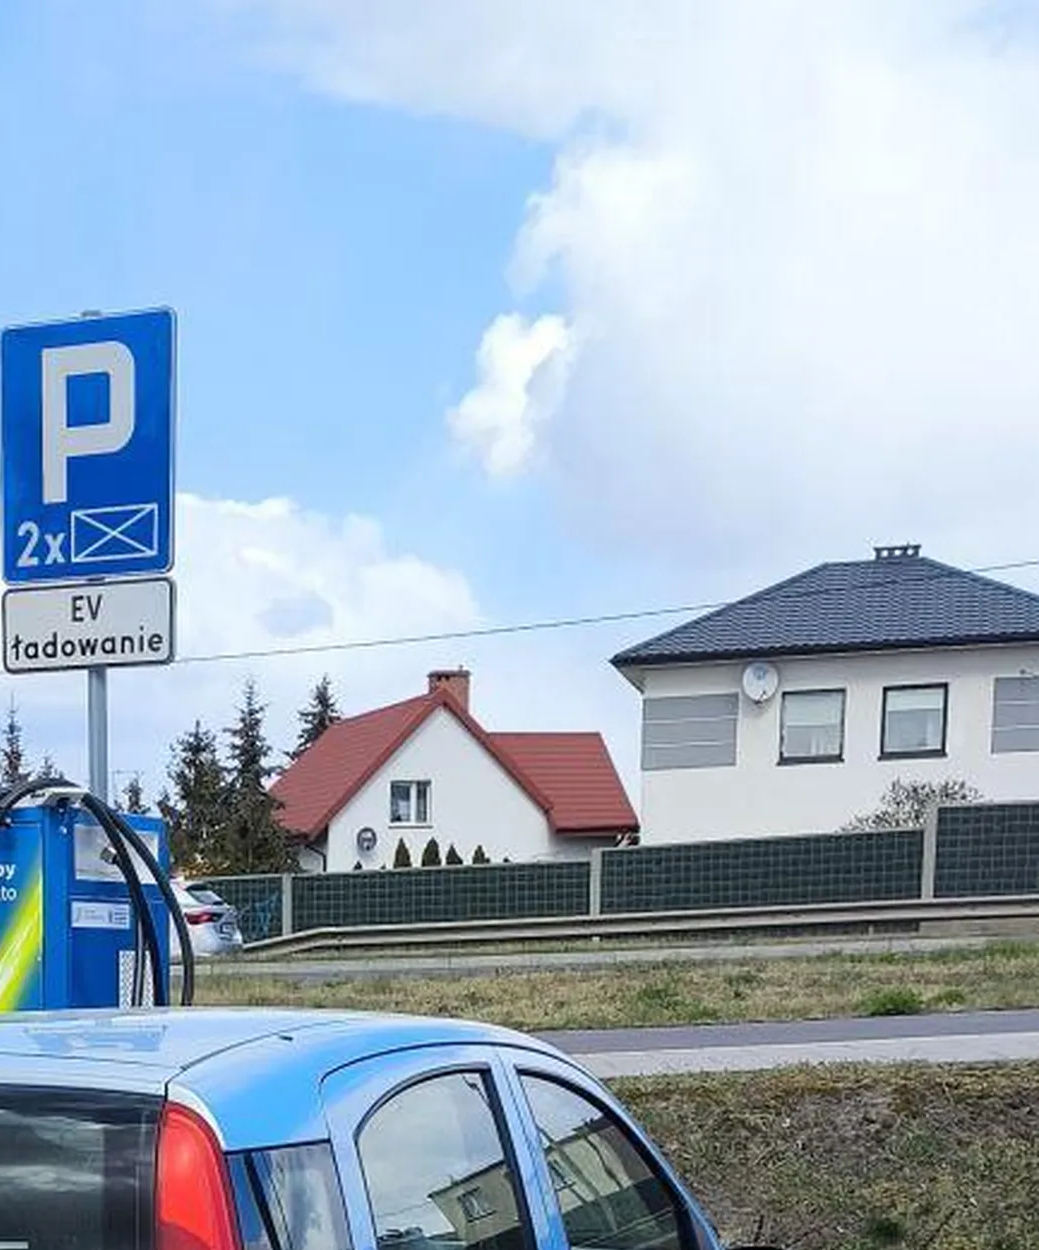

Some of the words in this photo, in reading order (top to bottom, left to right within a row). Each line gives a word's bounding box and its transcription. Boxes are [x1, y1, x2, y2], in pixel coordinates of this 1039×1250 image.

[41, 340, 136, 505] P
[16, 520, 66, 568] 2x
[70, 594, 103, 623] EV
[10, 626, 164, 662] ładowanie
